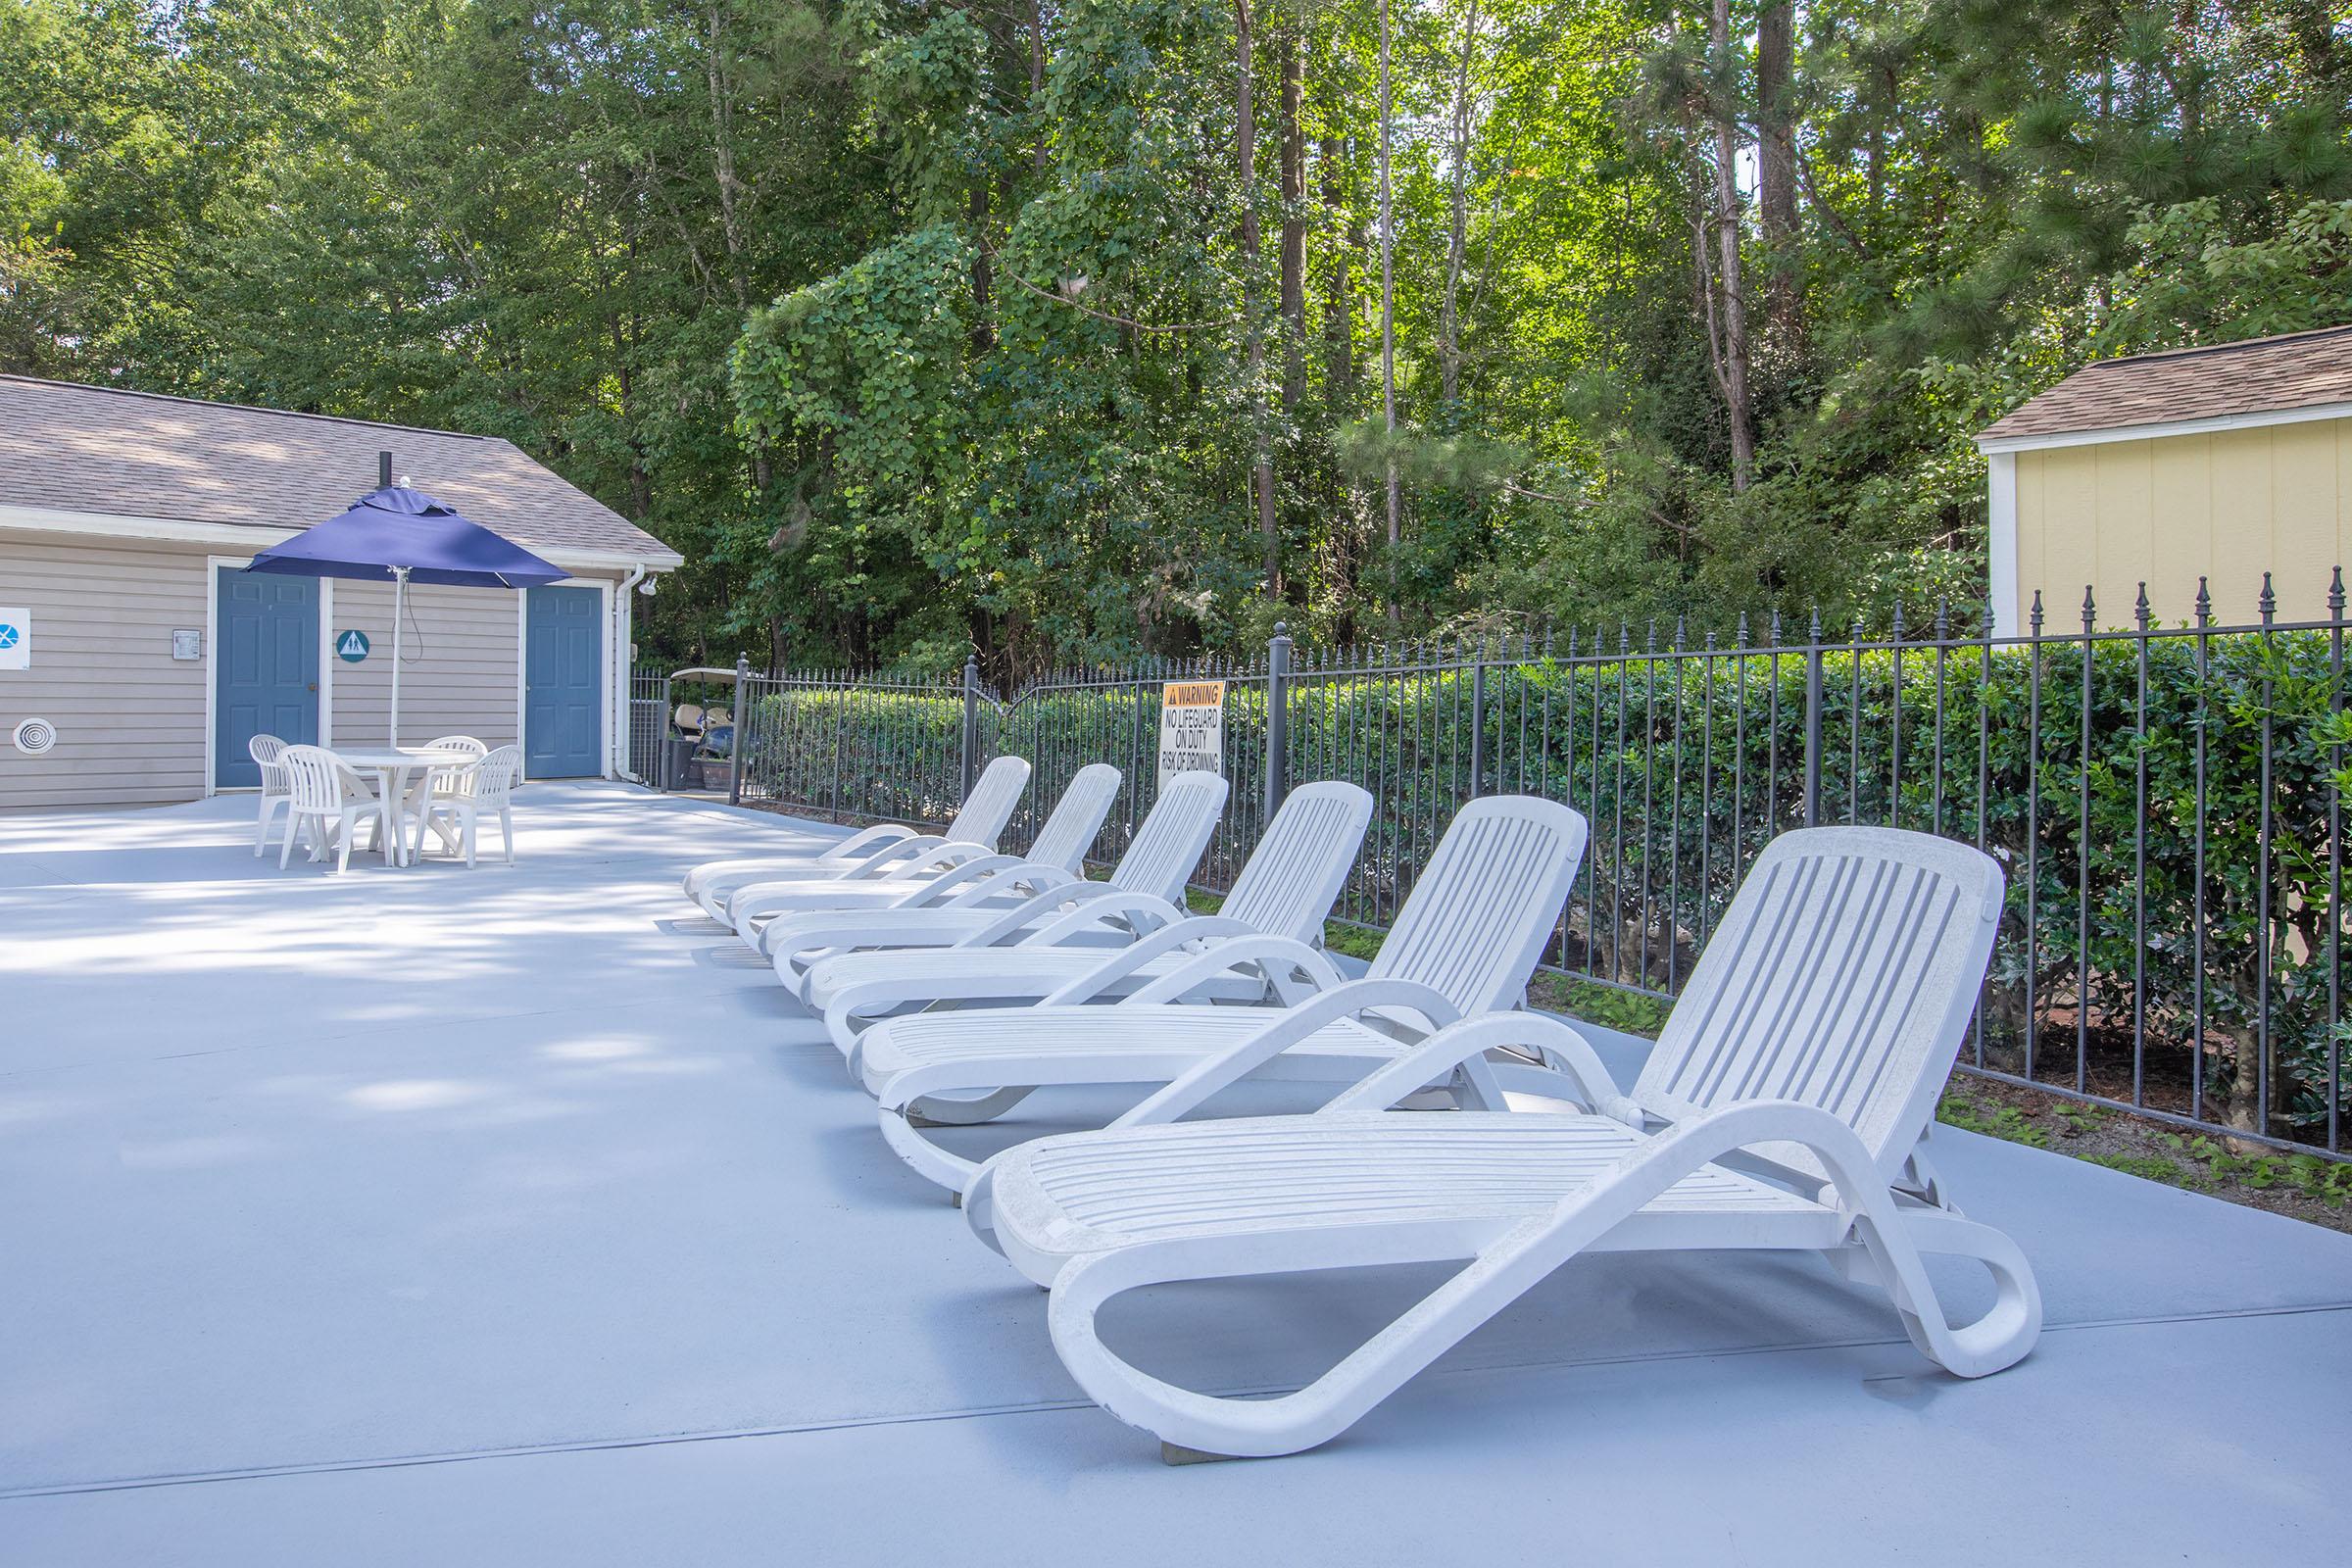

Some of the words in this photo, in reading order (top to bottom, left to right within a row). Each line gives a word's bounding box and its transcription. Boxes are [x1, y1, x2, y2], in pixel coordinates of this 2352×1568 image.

[1179, 685, 1218, 705] WARNING
[1165, 710, 1177, 728] NO
[1179, 709, 1217, 728] LIFEGUARD
[1176, 729, 1187, 749] ON
[1189, 729, 1207, 749] DUTY
[1161, 751, 1176, 770] RISK
[1177, 752, 1186, 771] OF
[1187, 752, 1218, 773] DROWNING
